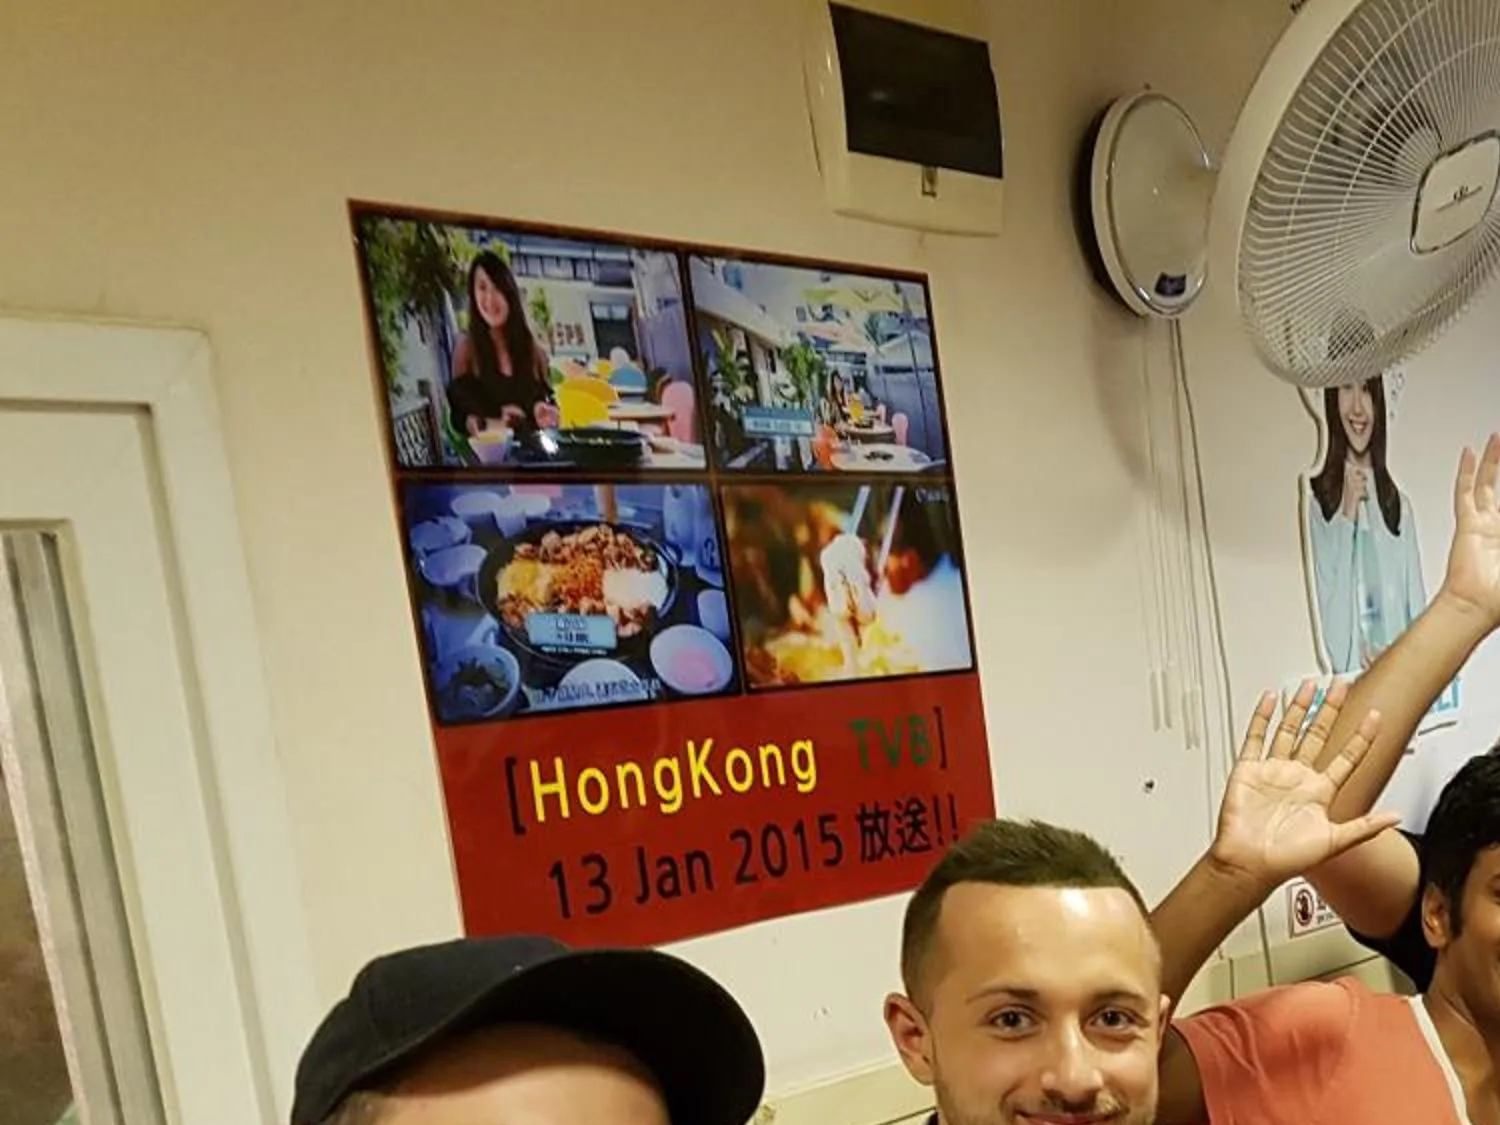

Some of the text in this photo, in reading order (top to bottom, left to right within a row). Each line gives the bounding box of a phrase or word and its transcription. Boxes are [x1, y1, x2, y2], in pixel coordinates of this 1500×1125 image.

[548, 852, 612, 919] 13
[635, 845, 714, 905] Jan
[730, 814, 844, 887] 2015
